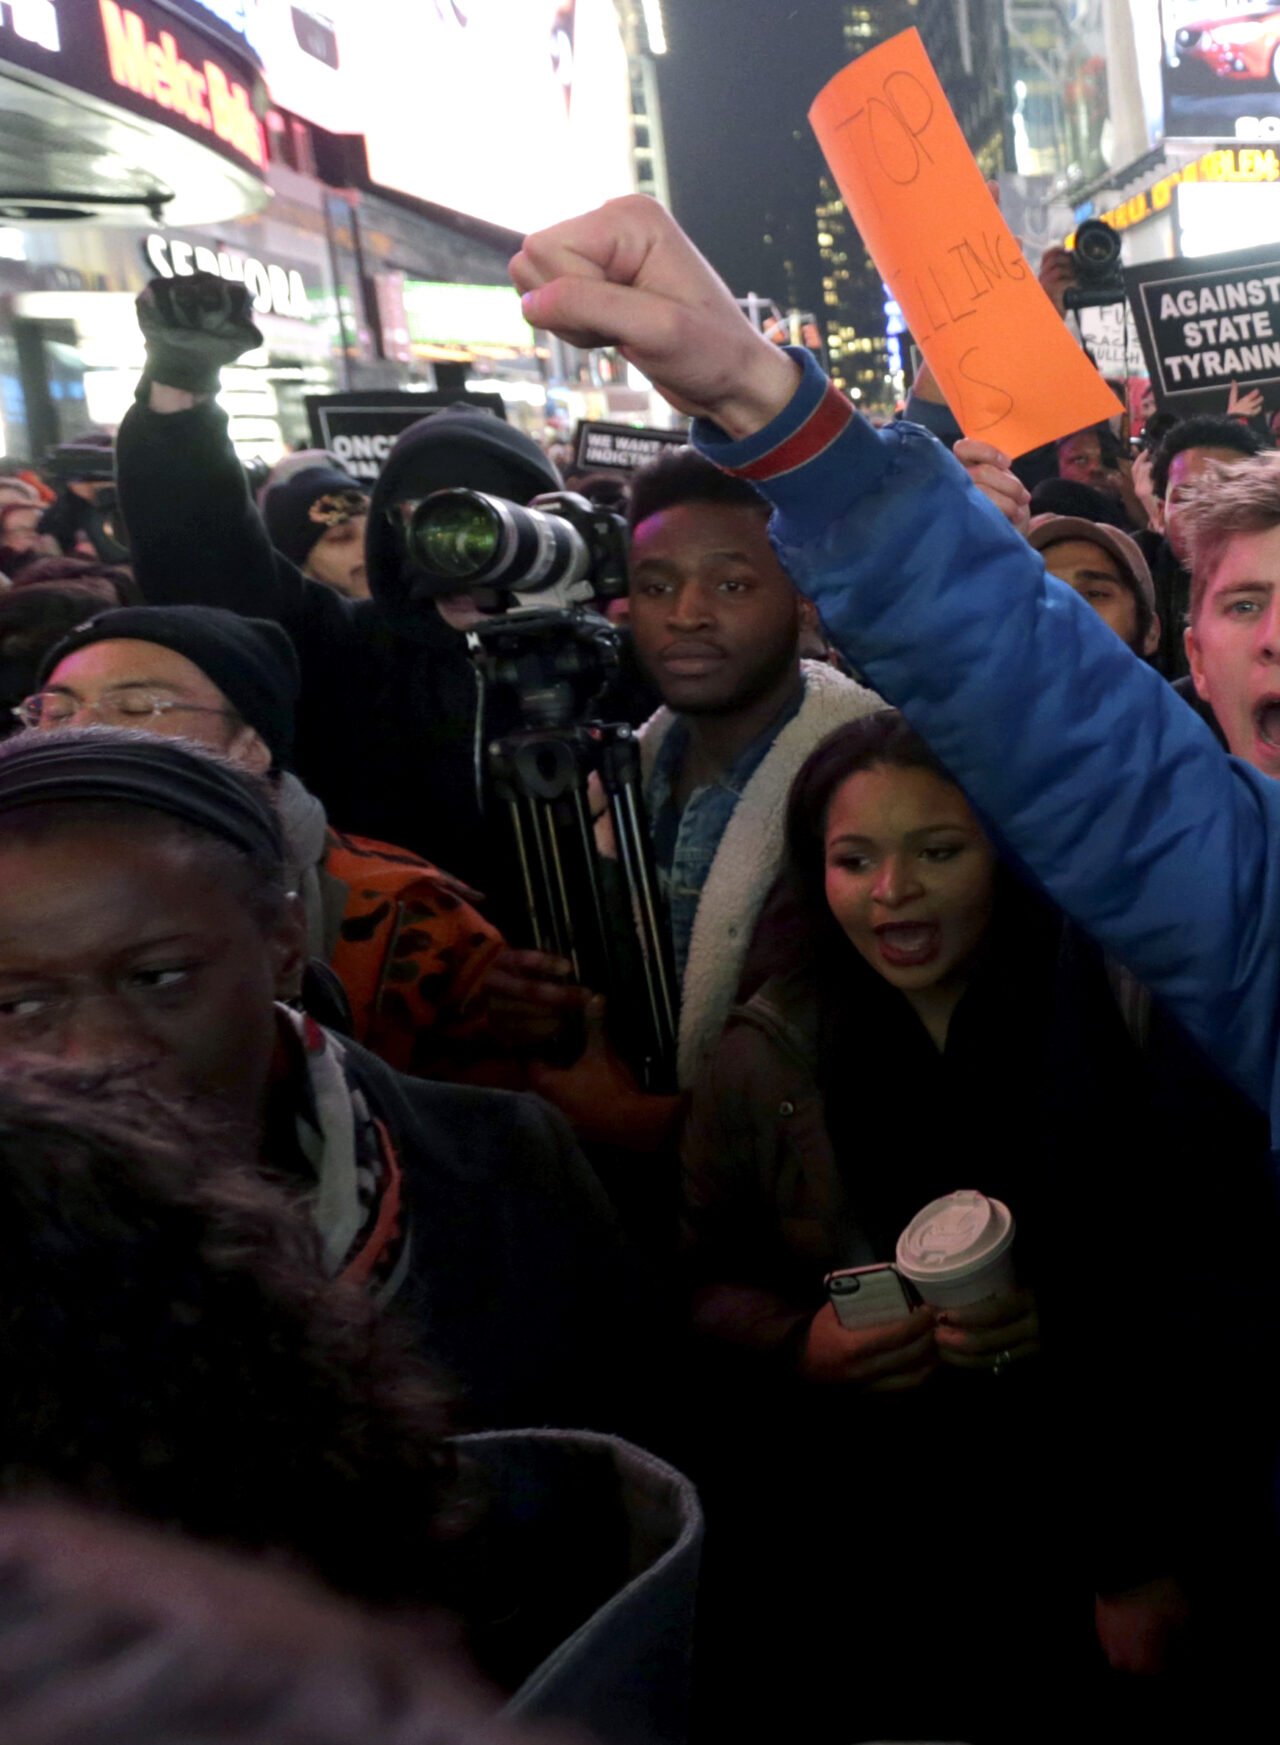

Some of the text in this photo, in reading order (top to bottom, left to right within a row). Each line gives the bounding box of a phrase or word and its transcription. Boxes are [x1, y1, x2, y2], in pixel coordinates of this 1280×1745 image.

[834, 70, 934, 214] TOP
[1183, 311, 1273, 348] STATE
[588, 432, 613, 448] WE
[615, 436, 660, 453] WANT
